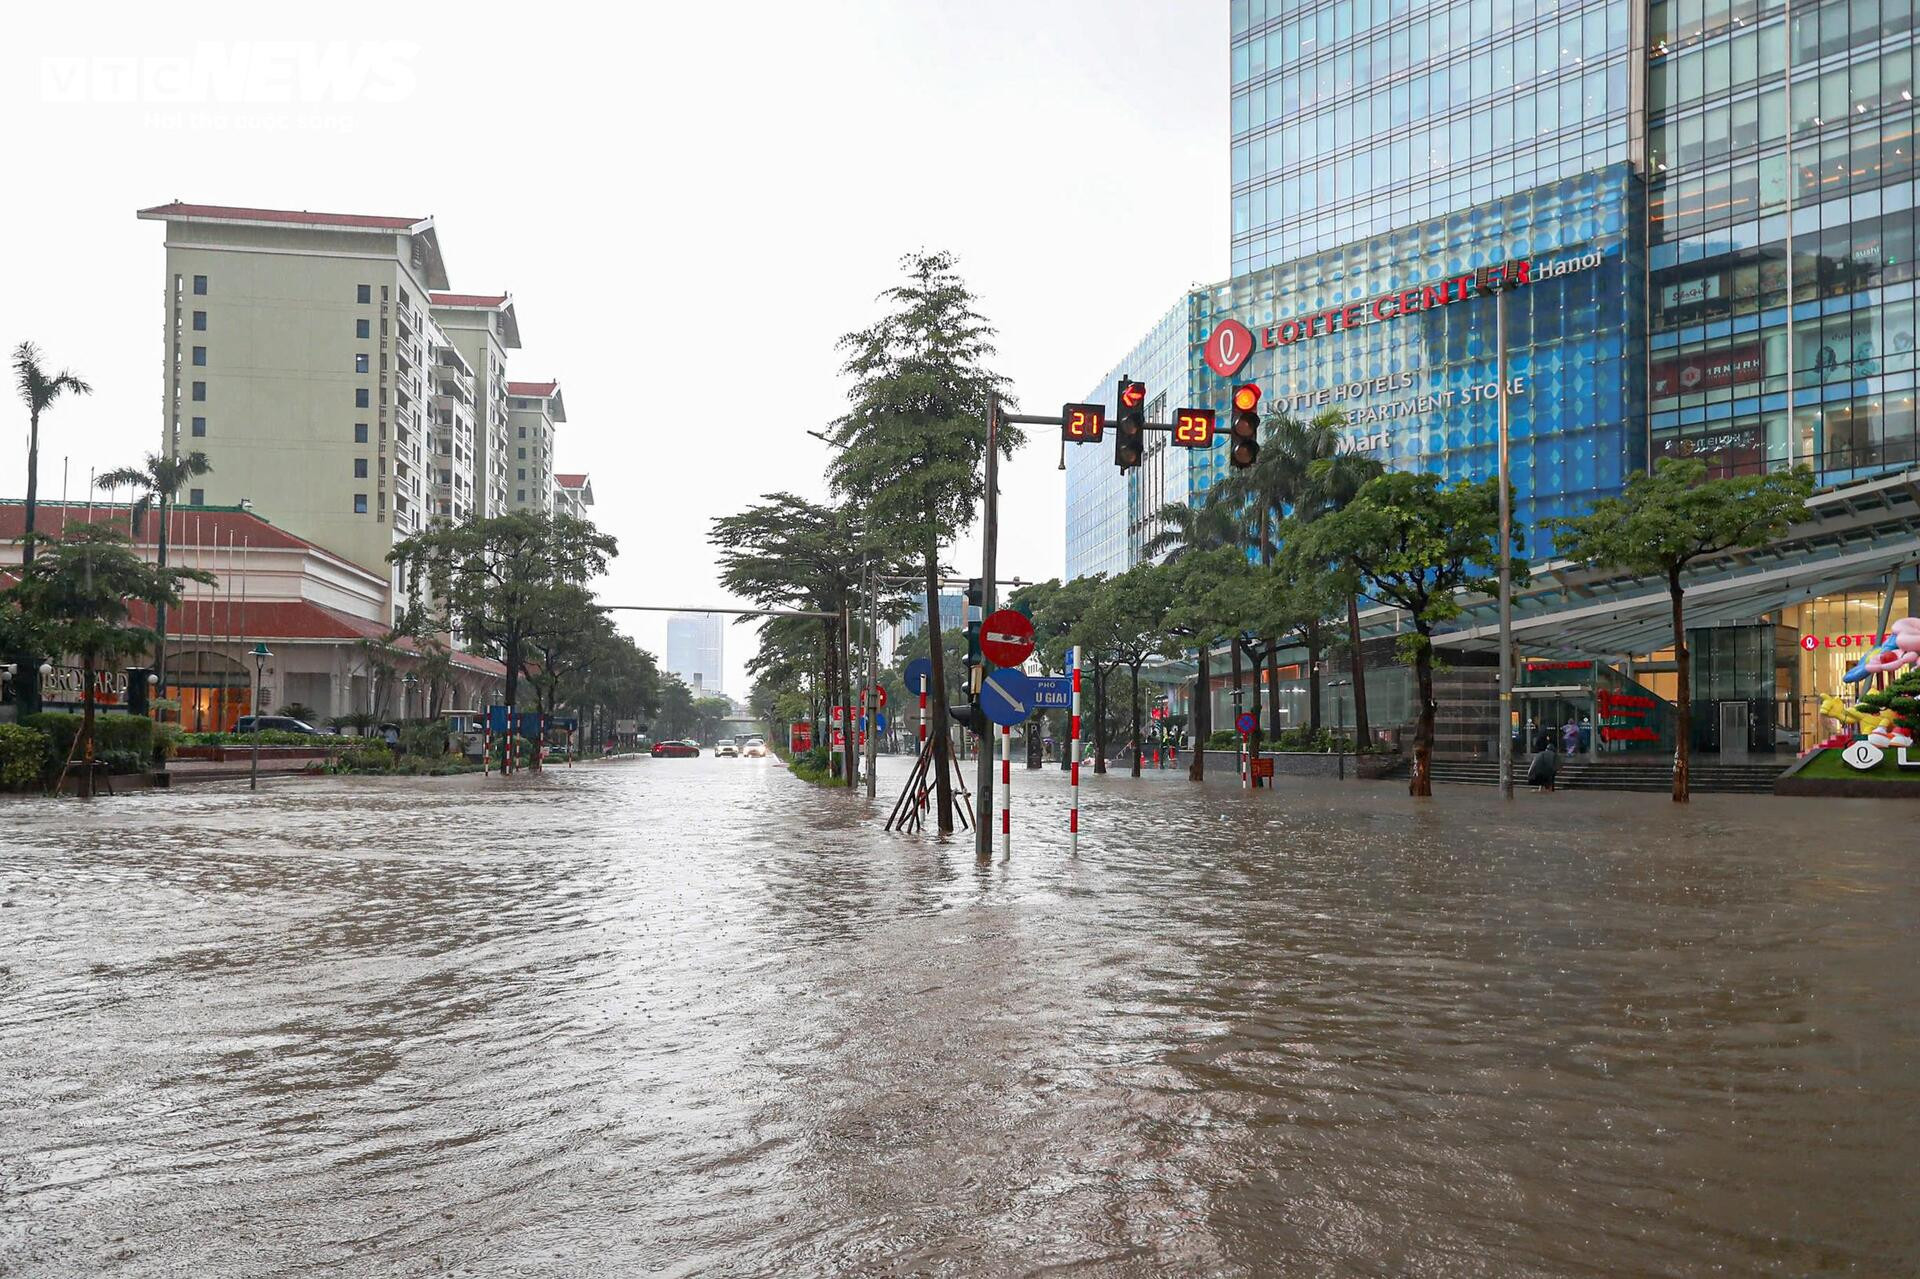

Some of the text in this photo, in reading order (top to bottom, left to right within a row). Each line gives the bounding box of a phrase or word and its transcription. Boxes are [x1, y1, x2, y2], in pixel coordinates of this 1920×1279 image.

[1261, 303, 1361, 349] LOTTE
[1539, 246, 1602, 280] Hanoi
[1263, 372, 1413, 415] LOTTE HOTELS
[1461, 377, 1526, 405] STORE
[1071, 412, 1097, 435] 21
[1178, 416, 1207, 441] 23
[1335, 429, 1391, 456] Mart
[42, 668, 129, 693] BROARD
[1045, 692, 1067, 704] GIAI
